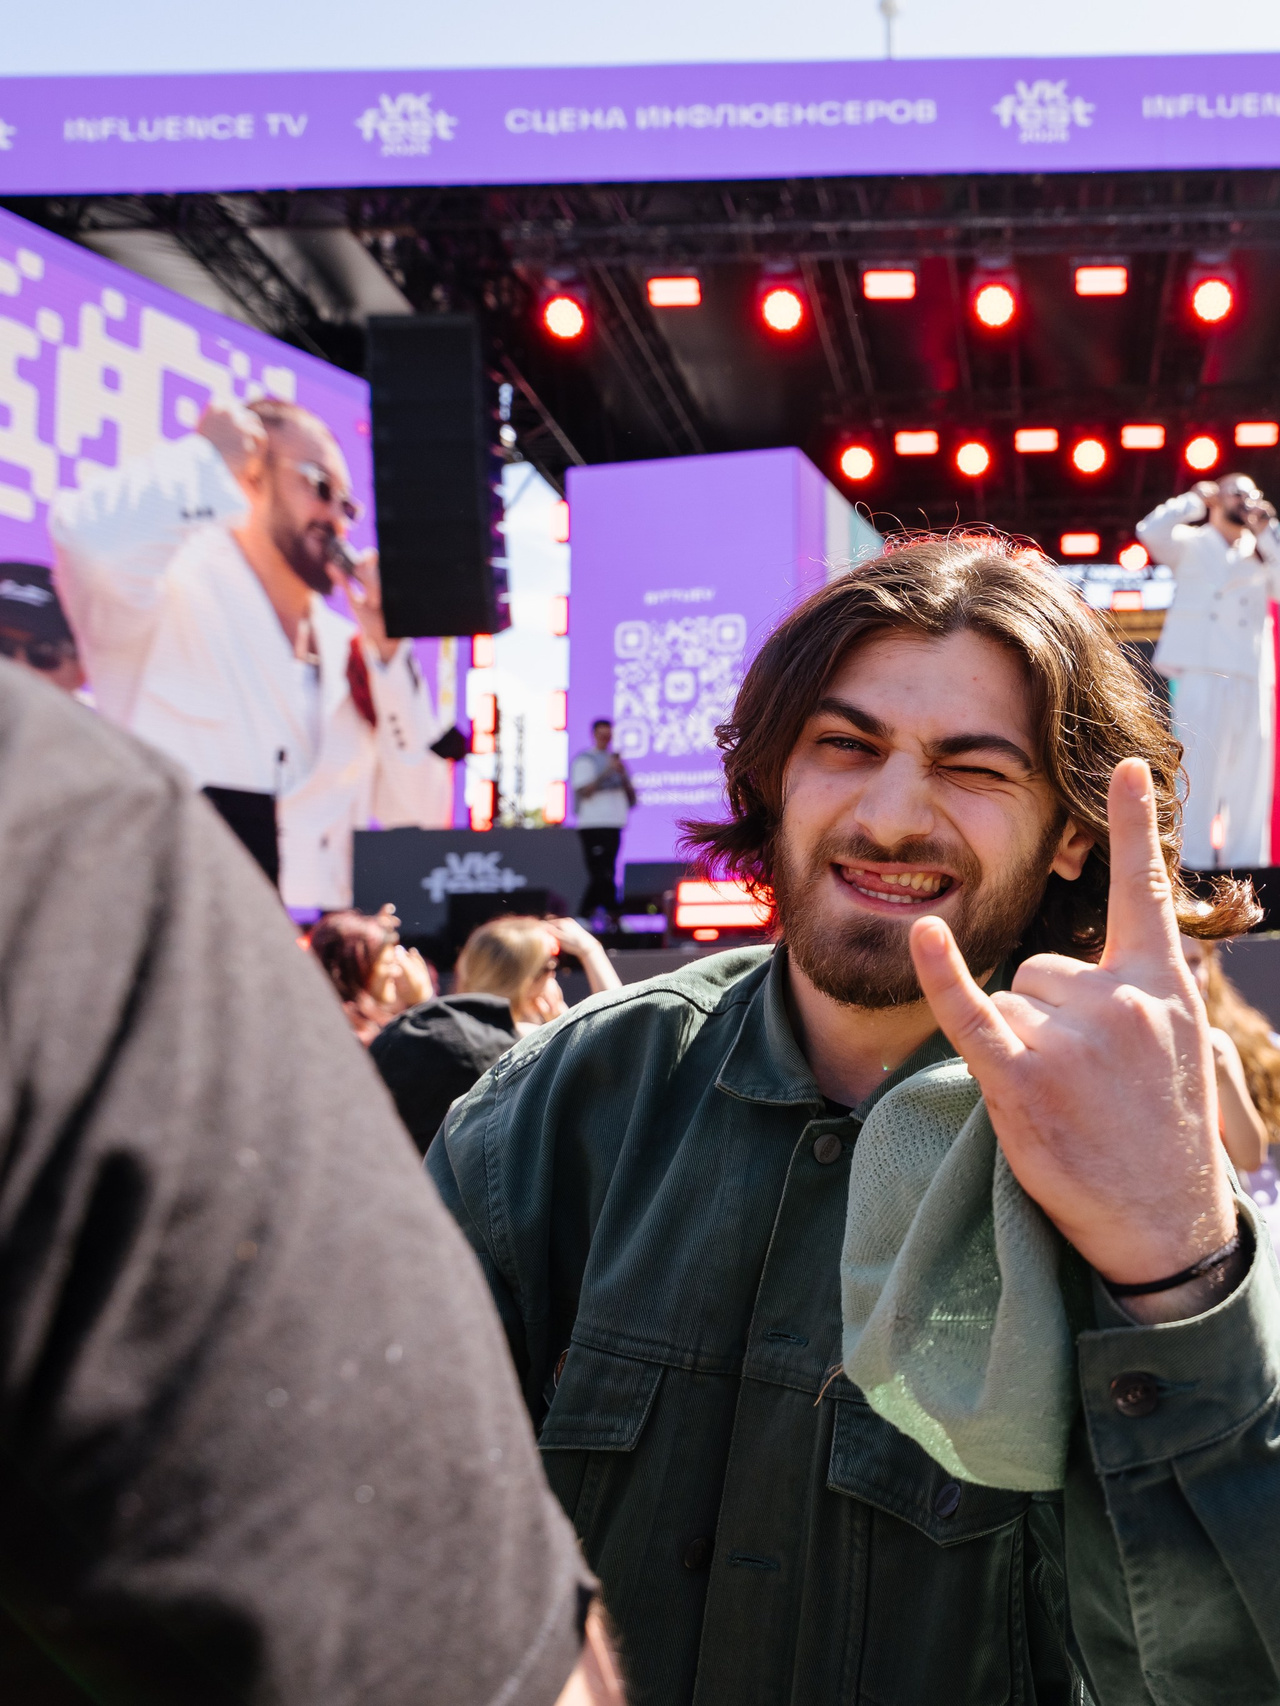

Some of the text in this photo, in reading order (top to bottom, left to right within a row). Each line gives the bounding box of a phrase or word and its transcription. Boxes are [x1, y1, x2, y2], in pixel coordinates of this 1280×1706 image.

[379, 92, 432, 118] VK
[1015, 79, 1069, 105] VK
[63, 112, 309, 143] INFLUENCE TV
[504, 98, 938, 135] СЦЕНА ИНФЛЮЕНСЕРОВ
